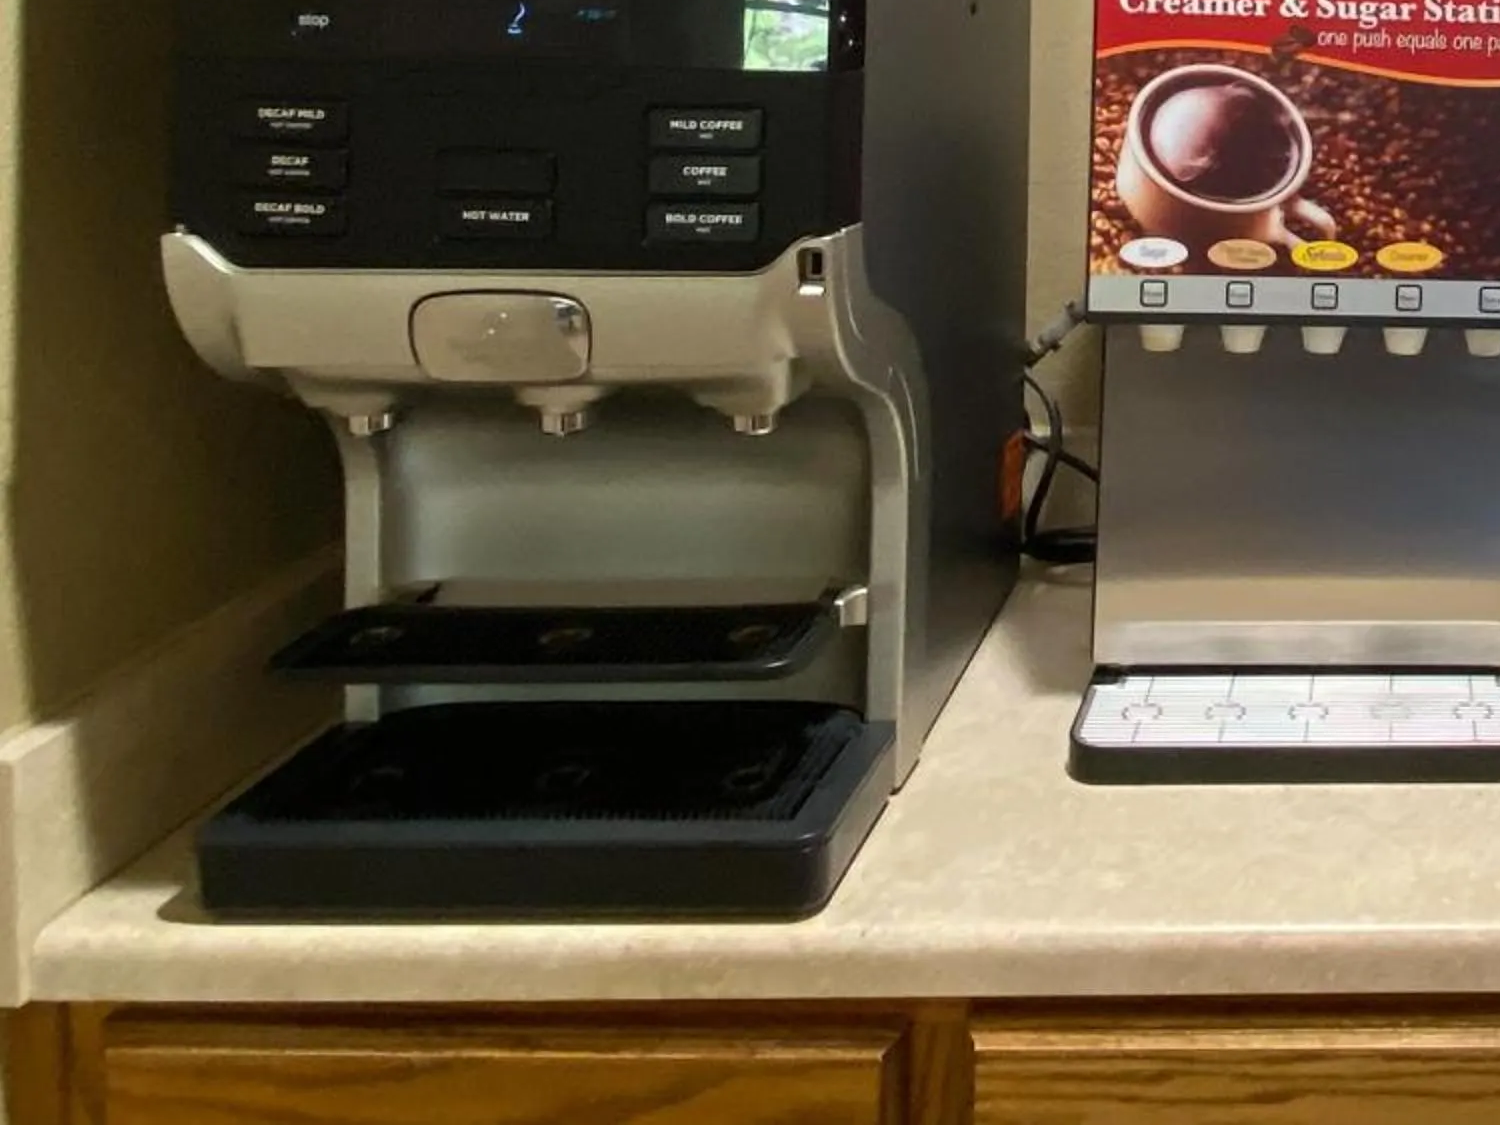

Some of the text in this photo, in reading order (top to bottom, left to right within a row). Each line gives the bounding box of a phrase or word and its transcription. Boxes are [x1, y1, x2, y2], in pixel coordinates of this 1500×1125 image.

[1317, 31, 1348, 46] one
[1352, 28, 1391, 54] push
[1396, 28, 1447, 54] equals
[1453, 33, 1482, 50] one
[669, 120, 744, 131] MILD COFFEE
[683, 166, 728, 176] COFFEE
[699, 214, 743, 224] COFFEE
